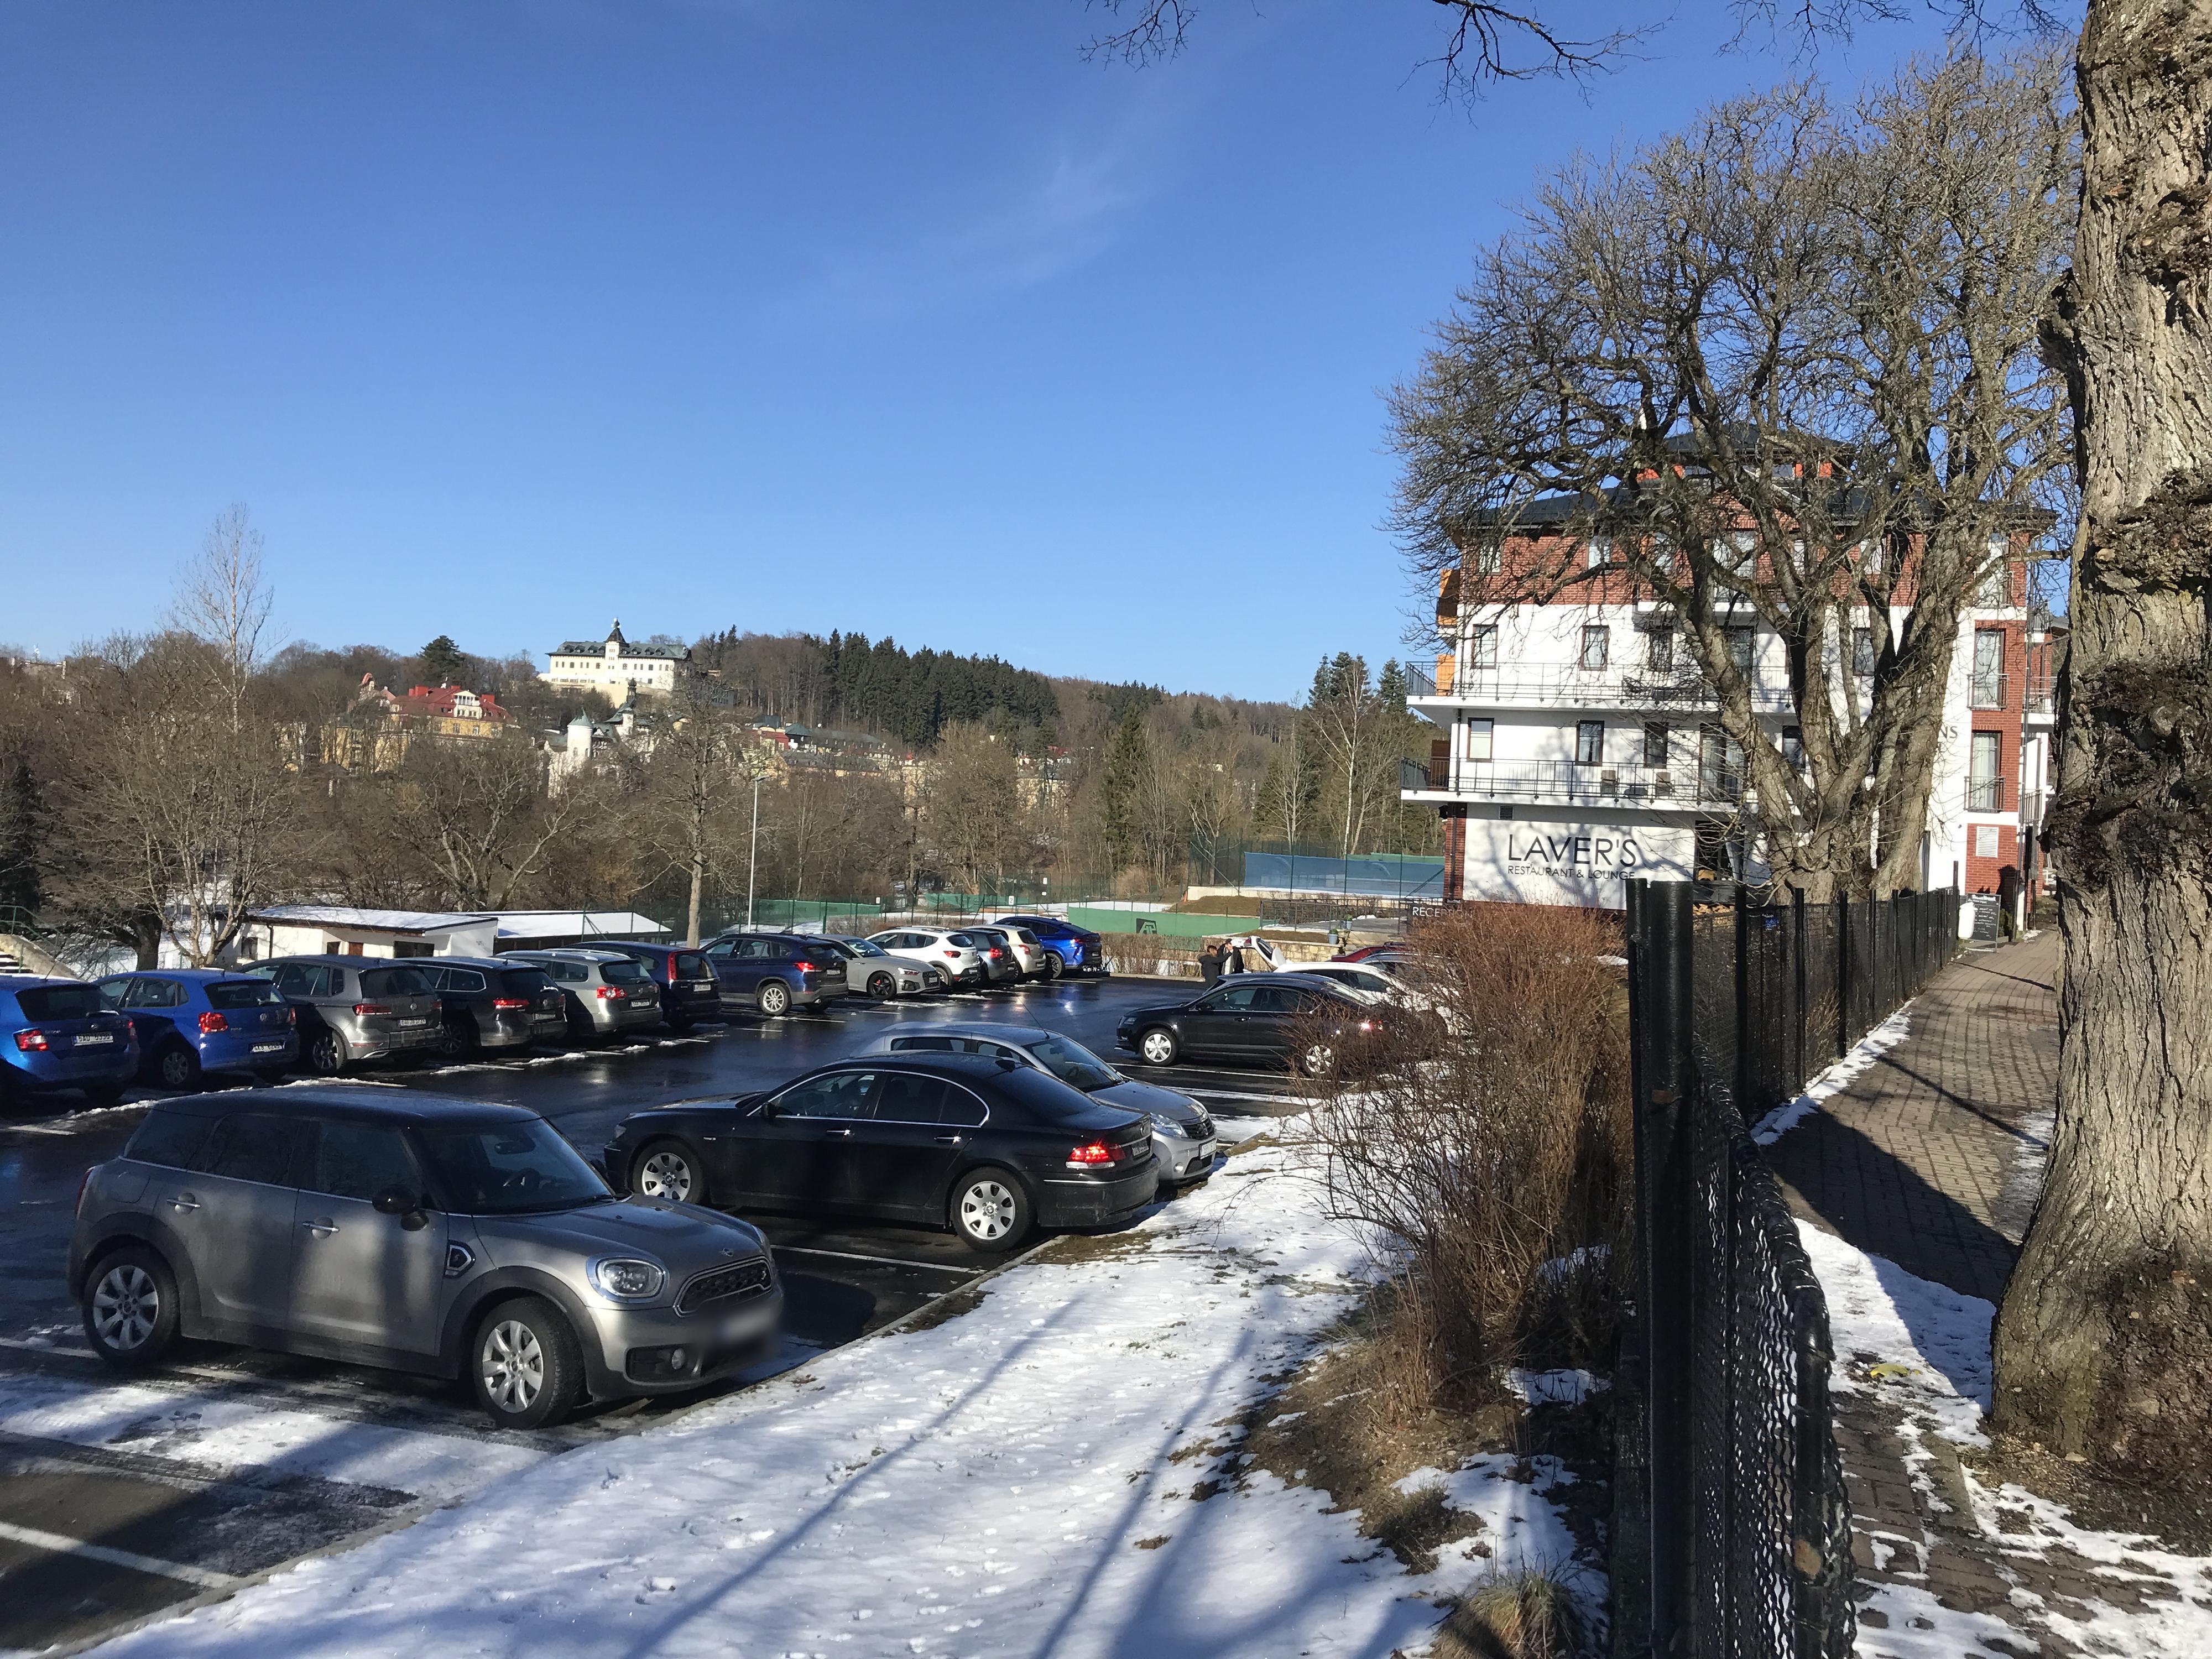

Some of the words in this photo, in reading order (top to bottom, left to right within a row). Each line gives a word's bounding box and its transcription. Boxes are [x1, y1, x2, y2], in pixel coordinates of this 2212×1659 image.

[1508, 834, 1637, 867] LAVER'S
[1508, 865, 1573, 878] RESTAURANT
[1576, 869, 1584, 878] &
[1588, 870, 1635, 880] LOUNGE
